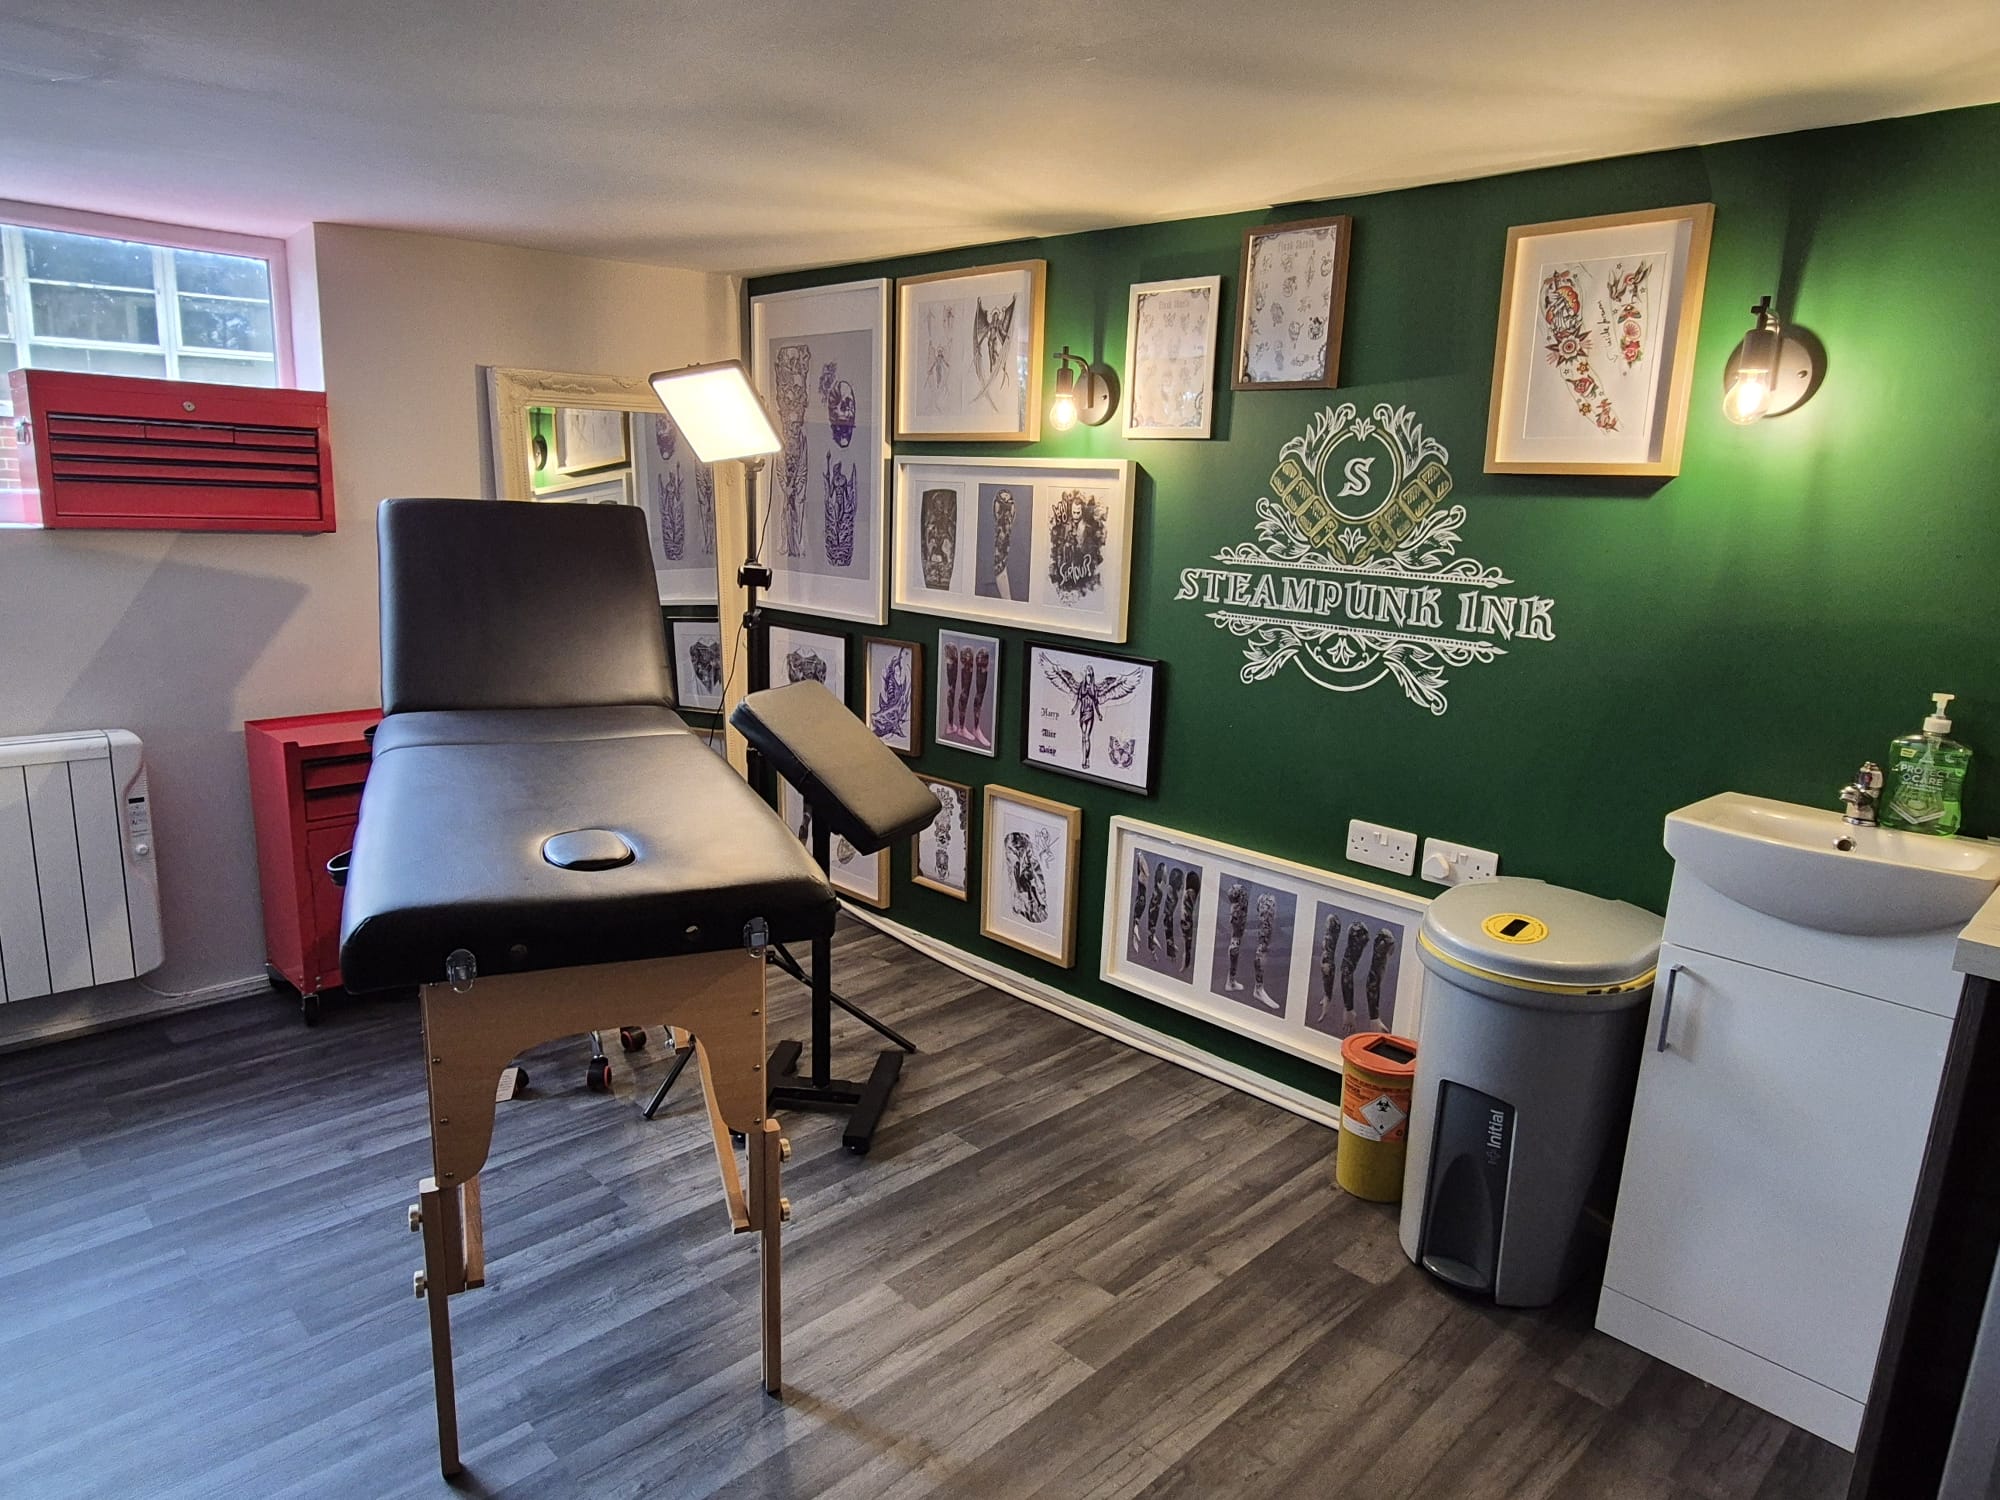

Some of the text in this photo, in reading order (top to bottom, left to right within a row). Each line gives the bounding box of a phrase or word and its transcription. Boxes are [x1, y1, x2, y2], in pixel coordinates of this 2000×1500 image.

[1337, 457, 1375, 497] S
[1174, 567, 1556, 642] STEAMPUNK INK
[1487, 1109, 1504, 1149] Initial
